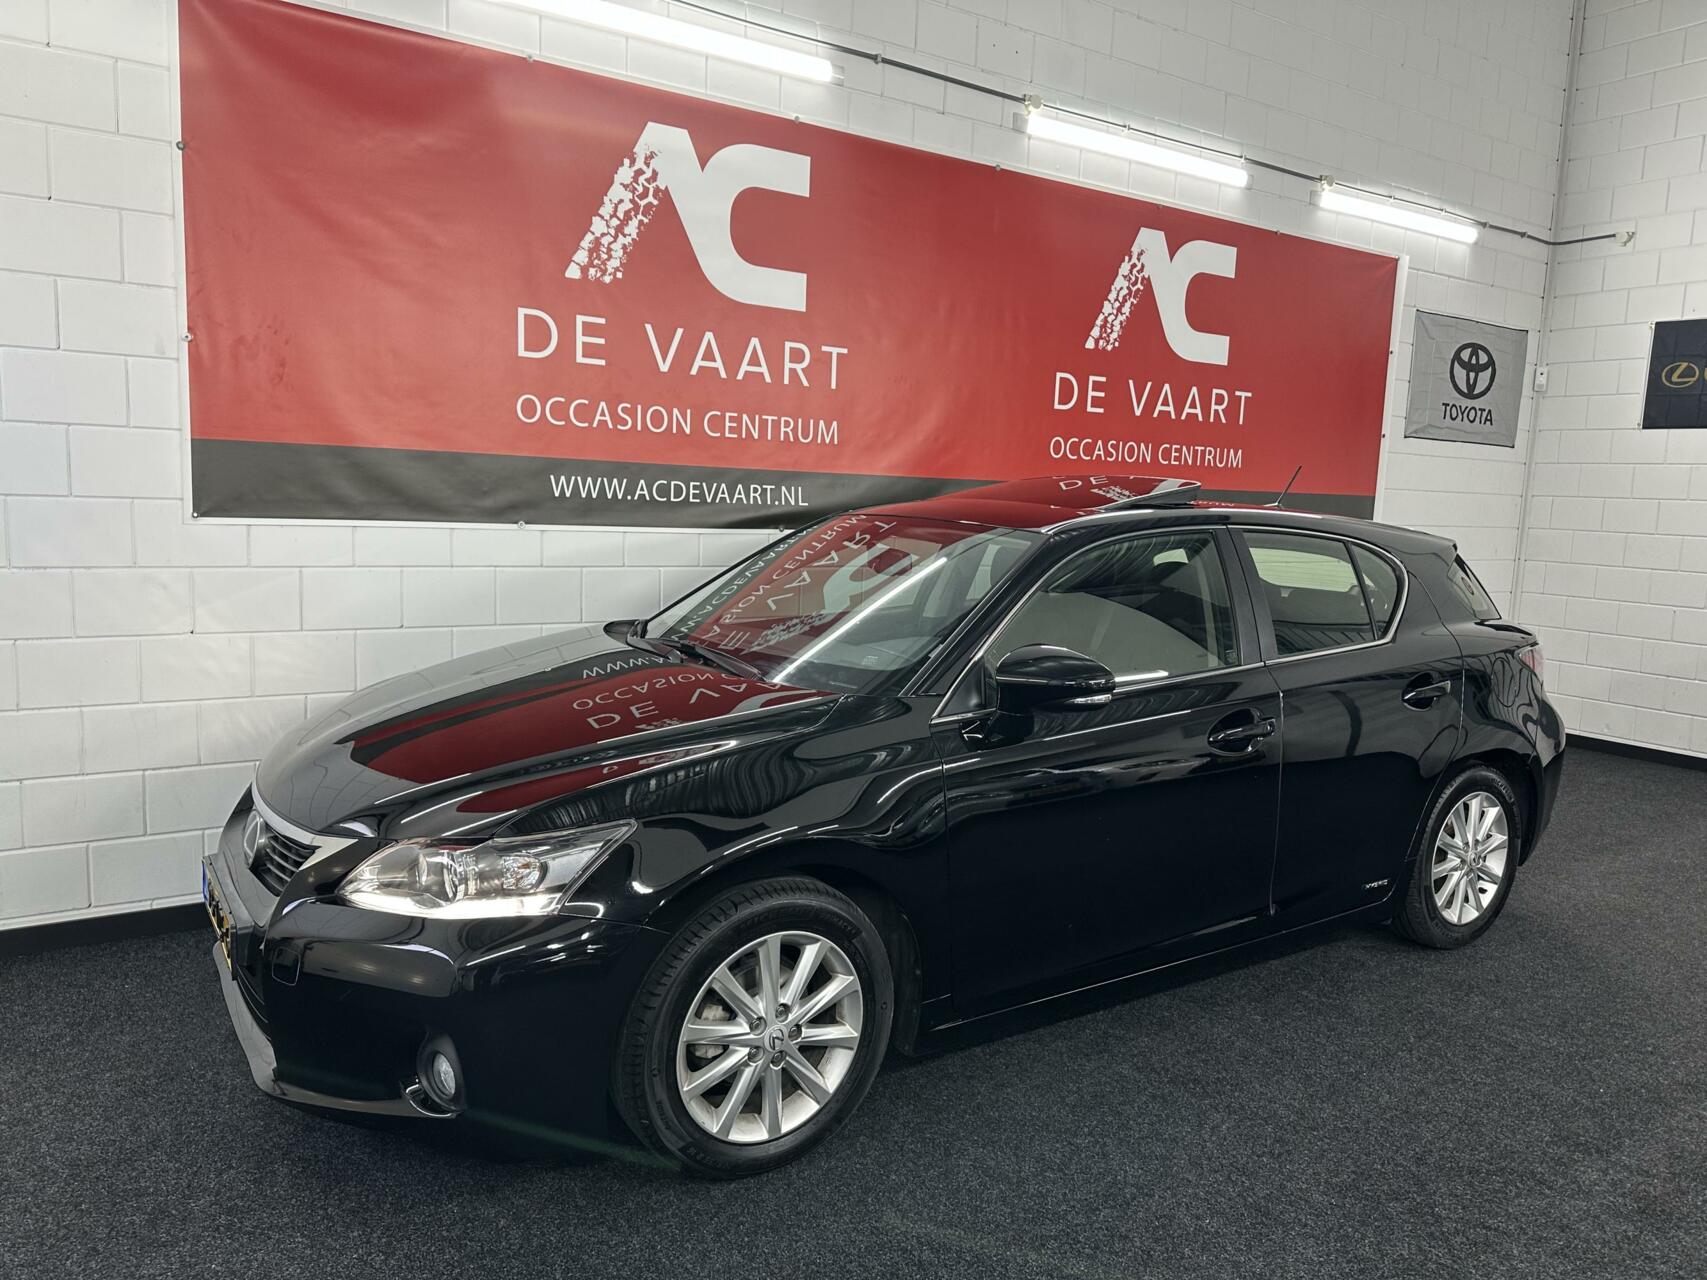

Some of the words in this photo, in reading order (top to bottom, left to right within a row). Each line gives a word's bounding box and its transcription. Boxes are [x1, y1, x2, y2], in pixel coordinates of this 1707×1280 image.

[517, 306, 607, 366] DE
[644, 322, 848, 389] VAART
[1053, 371, 1107, 414] DE
[1128, 379, 1252, 425] VAART
[1441, 402, 1494, 426] TOYOTA
[516, 394, 691, 435] OCCASION
[703, 410, 839, 445] CENTRUM
[1050, 436, 1152, 463] OCCASION
[1158, 443, 1242, 468] CENTRUM
[550, 474, 809, 507] WWW.ACDEVAART.NL
